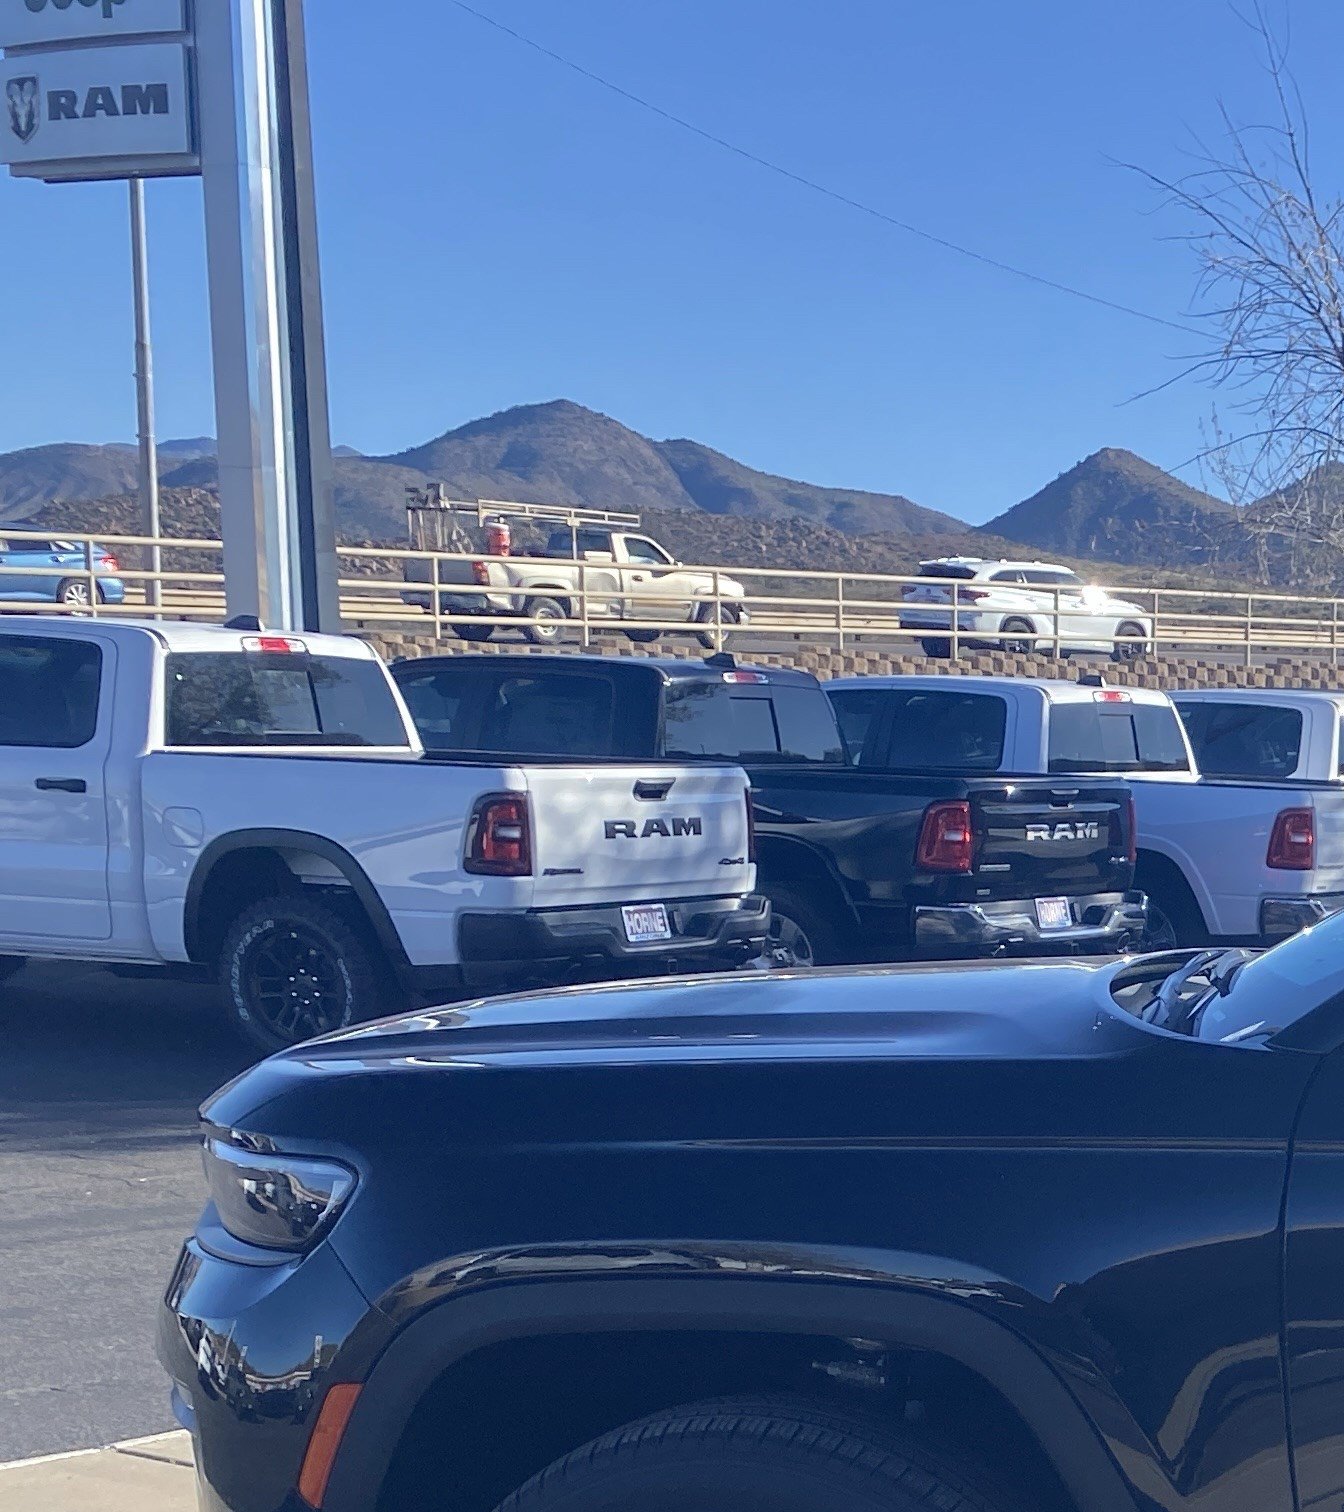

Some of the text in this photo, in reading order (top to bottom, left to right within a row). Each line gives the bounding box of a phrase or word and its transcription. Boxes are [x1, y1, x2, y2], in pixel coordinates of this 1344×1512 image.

[47, 83, 169, 121] RAM
[604, 817, 702, 839] RAM
[1025, 822, 1099, 841] RAM
[624, 910, 666, 935] HORNE
